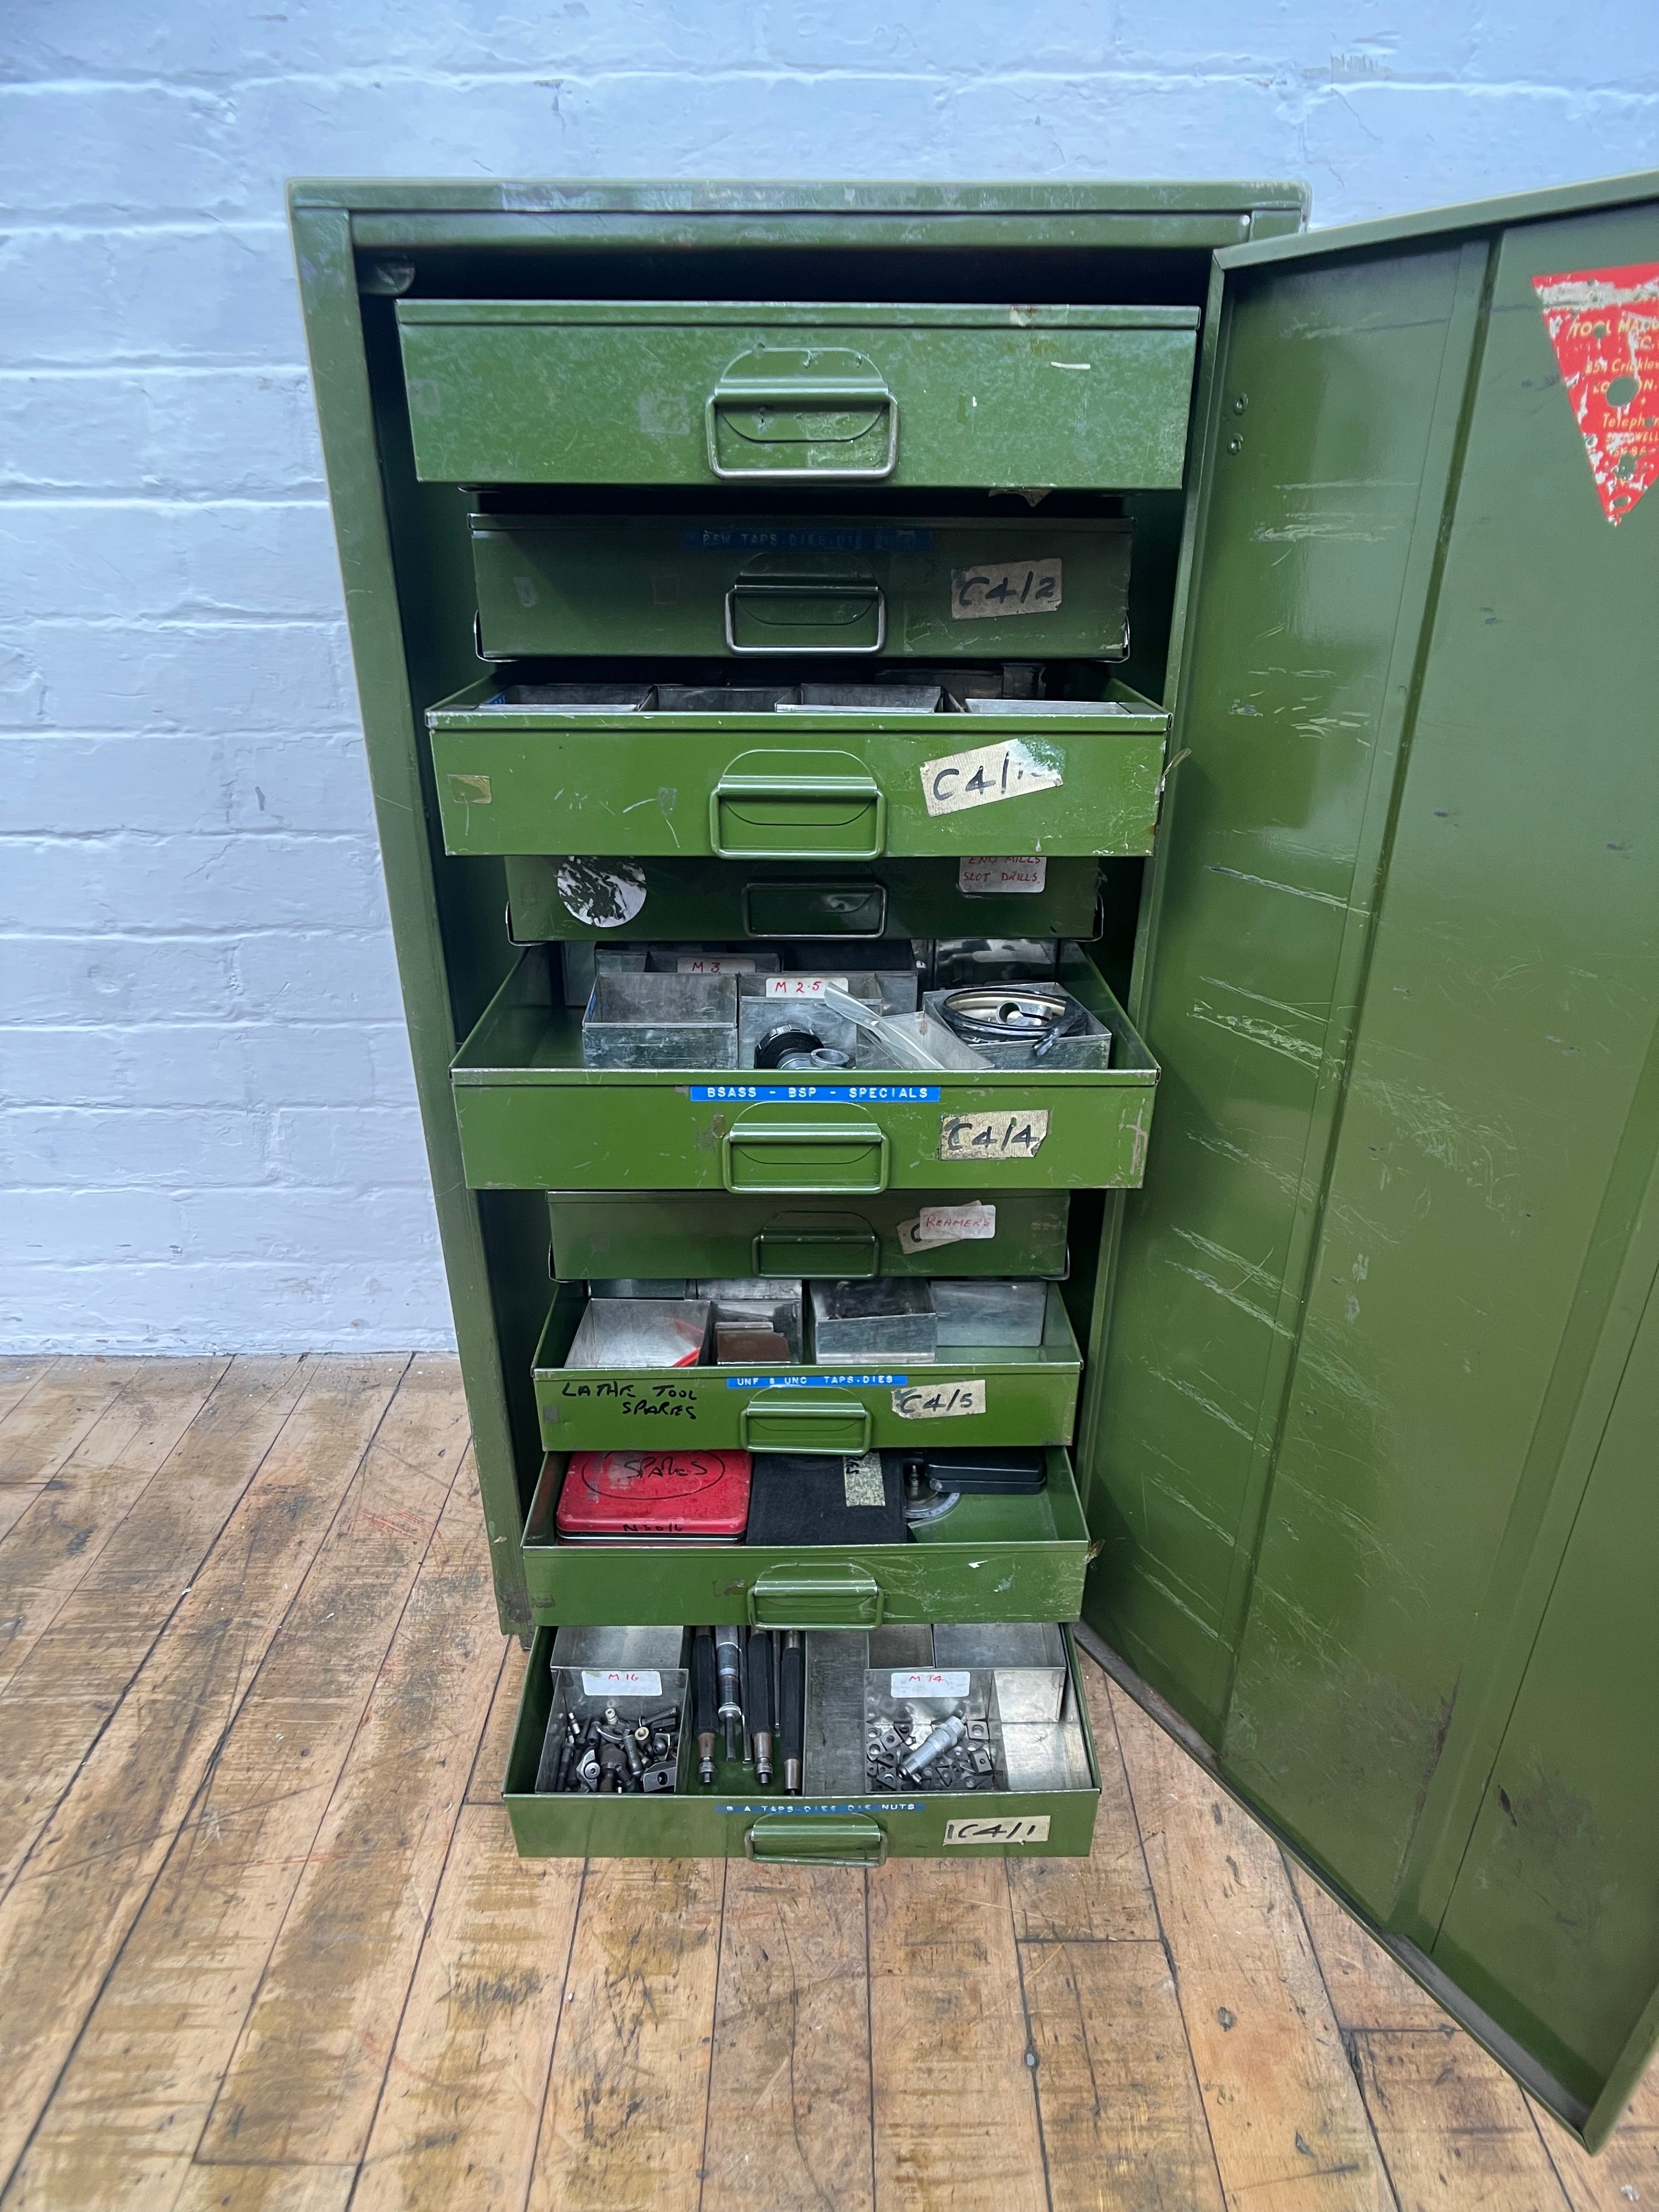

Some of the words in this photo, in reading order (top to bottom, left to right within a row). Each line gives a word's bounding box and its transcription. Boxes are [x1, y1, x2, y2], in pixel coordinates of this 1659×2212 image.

[959, 571, 1056, 606] C4/2
[963, 871, 991, 882] SLOT
[692, 962, 703, 973] M
[775, 981, 787, 993] M
[707, 1087, 757, 1098] BSASS
[788, 1087, 817, 1098] BSP
[849, 1087, 928, 1098] SPECIALS
[948, 1118, 1040, 1151] C4/4
[737, 1377, 759, 1386] UNF
[784, 1376, 807, 1385] UNC
[562, 1381, 636, 1398] LATHE
[653, 1384, 697, 1400] TOOL
[900, 1389, 973, 1413] C4/5
[622, 1400, 697, 1420] SPARES
